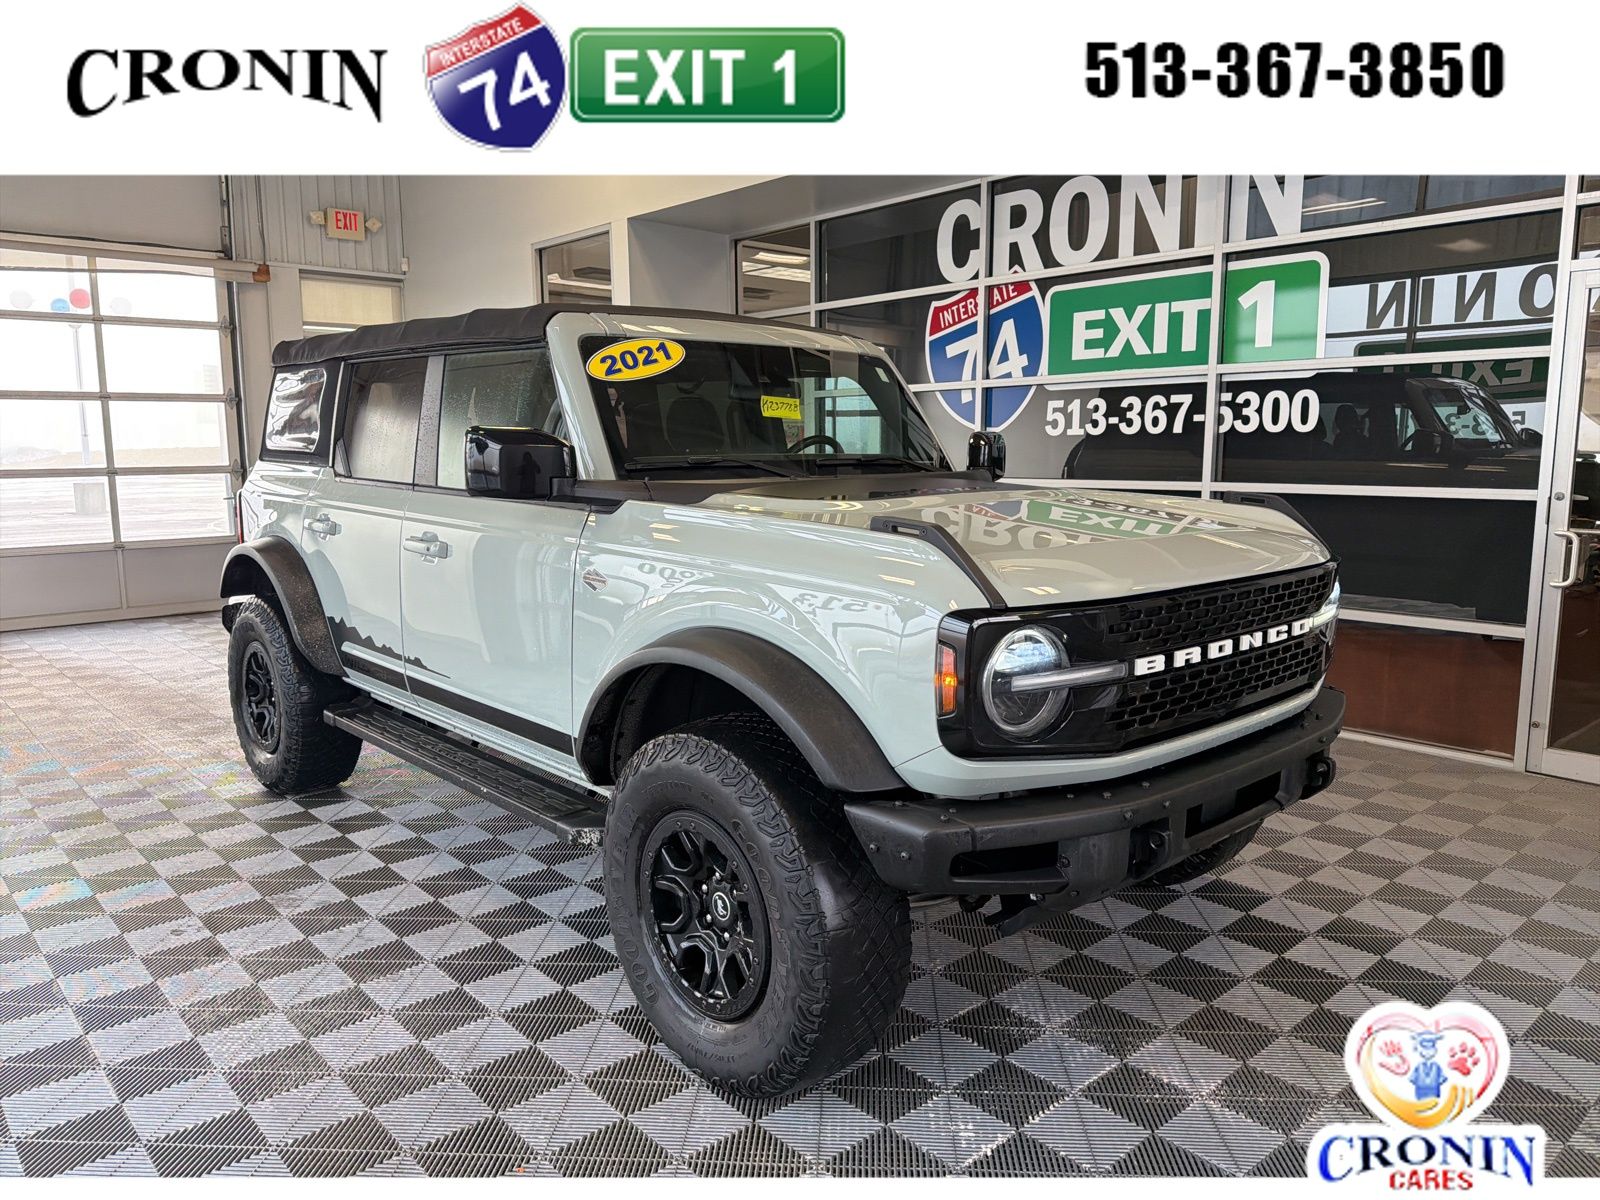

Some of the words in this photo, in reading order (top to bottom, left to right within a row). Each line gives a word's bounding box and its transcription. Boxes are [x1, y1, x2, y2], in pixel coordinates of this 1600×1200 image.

[335, 210, 358, 232] EXIT
[937, 175, 1305, 284] CRONIN
[1071, 297, 1213, 361] EXIT
[1237, 281, 1277, 348] 1
[945, 318, 1029, 405] 74
[1044, 388, 1320, 437] 513-367-5300
[1134, 617, 1313, 677] BRONCO
